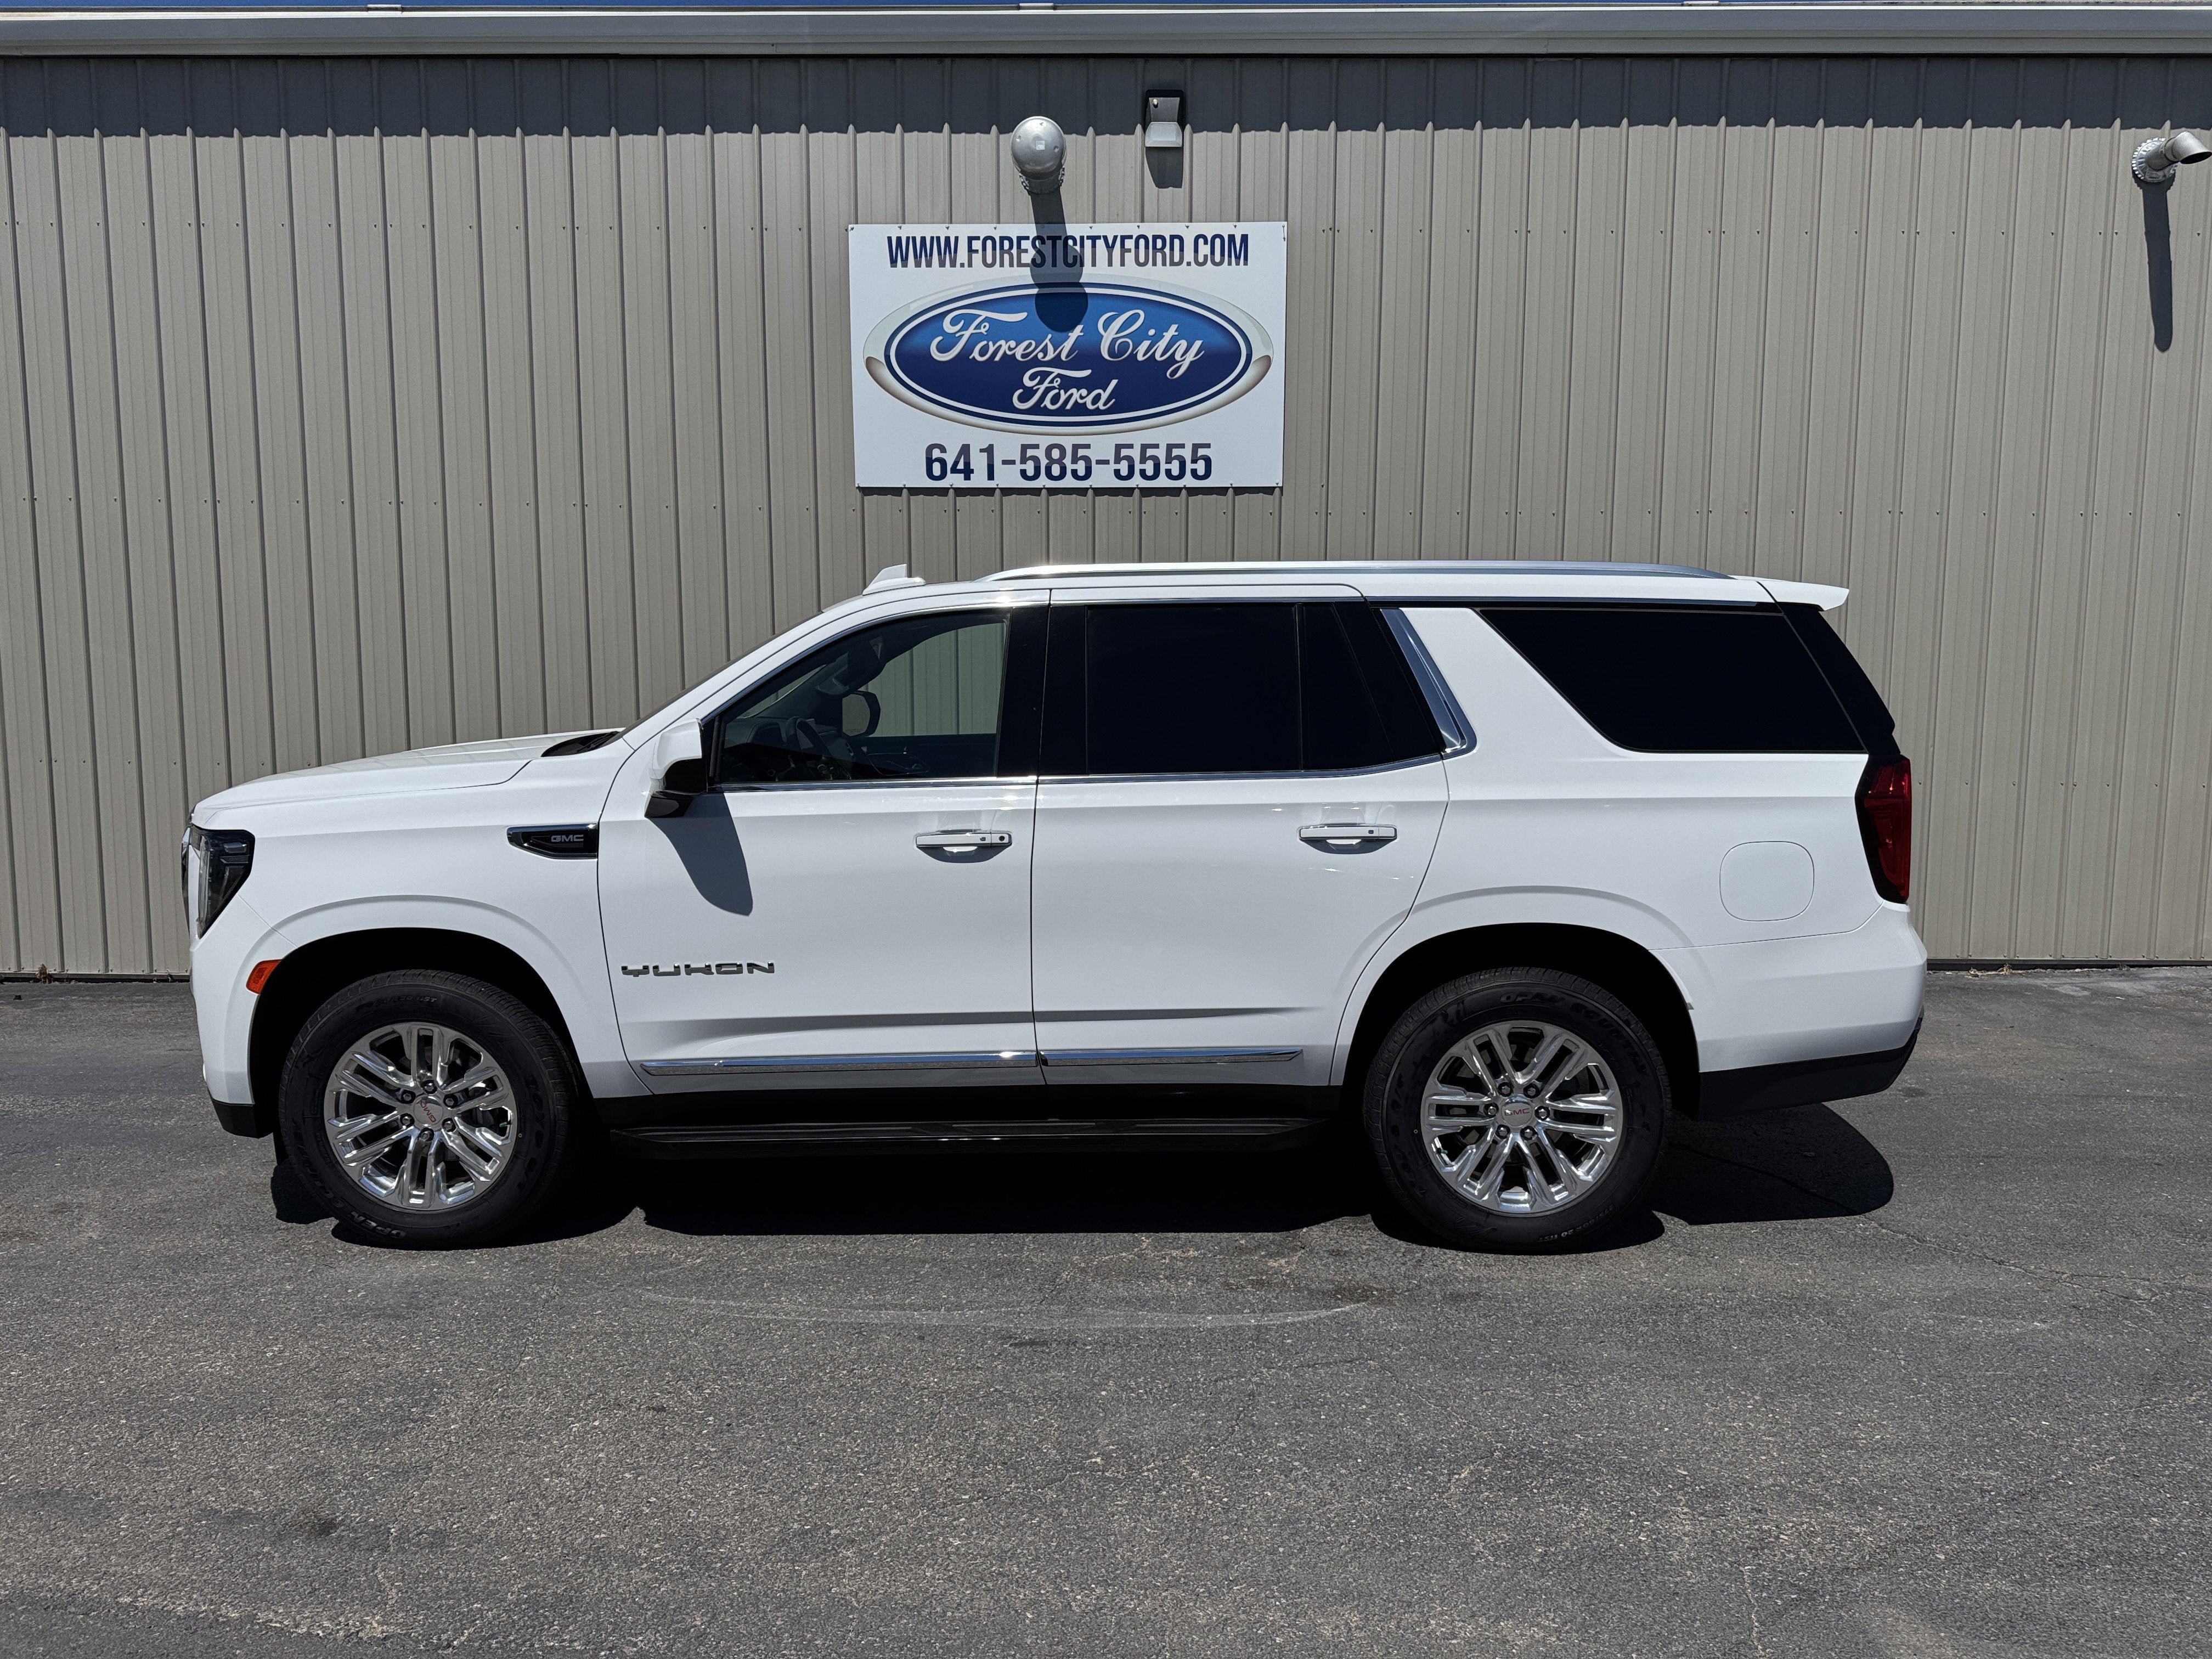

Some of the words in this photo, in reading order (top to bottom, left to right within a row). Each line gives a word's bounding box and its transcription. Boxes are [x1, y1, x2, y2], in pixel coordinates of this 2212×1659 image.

[887, 234, 1249, 268] WWW.FORESTCITYFORD.COM
[930, 309, 1084, 362] Forest
[1097, 309, 1205, 379] City
[1012, 367, 1116, 410] Ford
[925, 443, 1212, 482] 641-585-5555
[621, 961, 775, 978] YUKON
[420, 1101, 437, 1122] GMC
[1504, 1108, 1530, 1116] GMC
